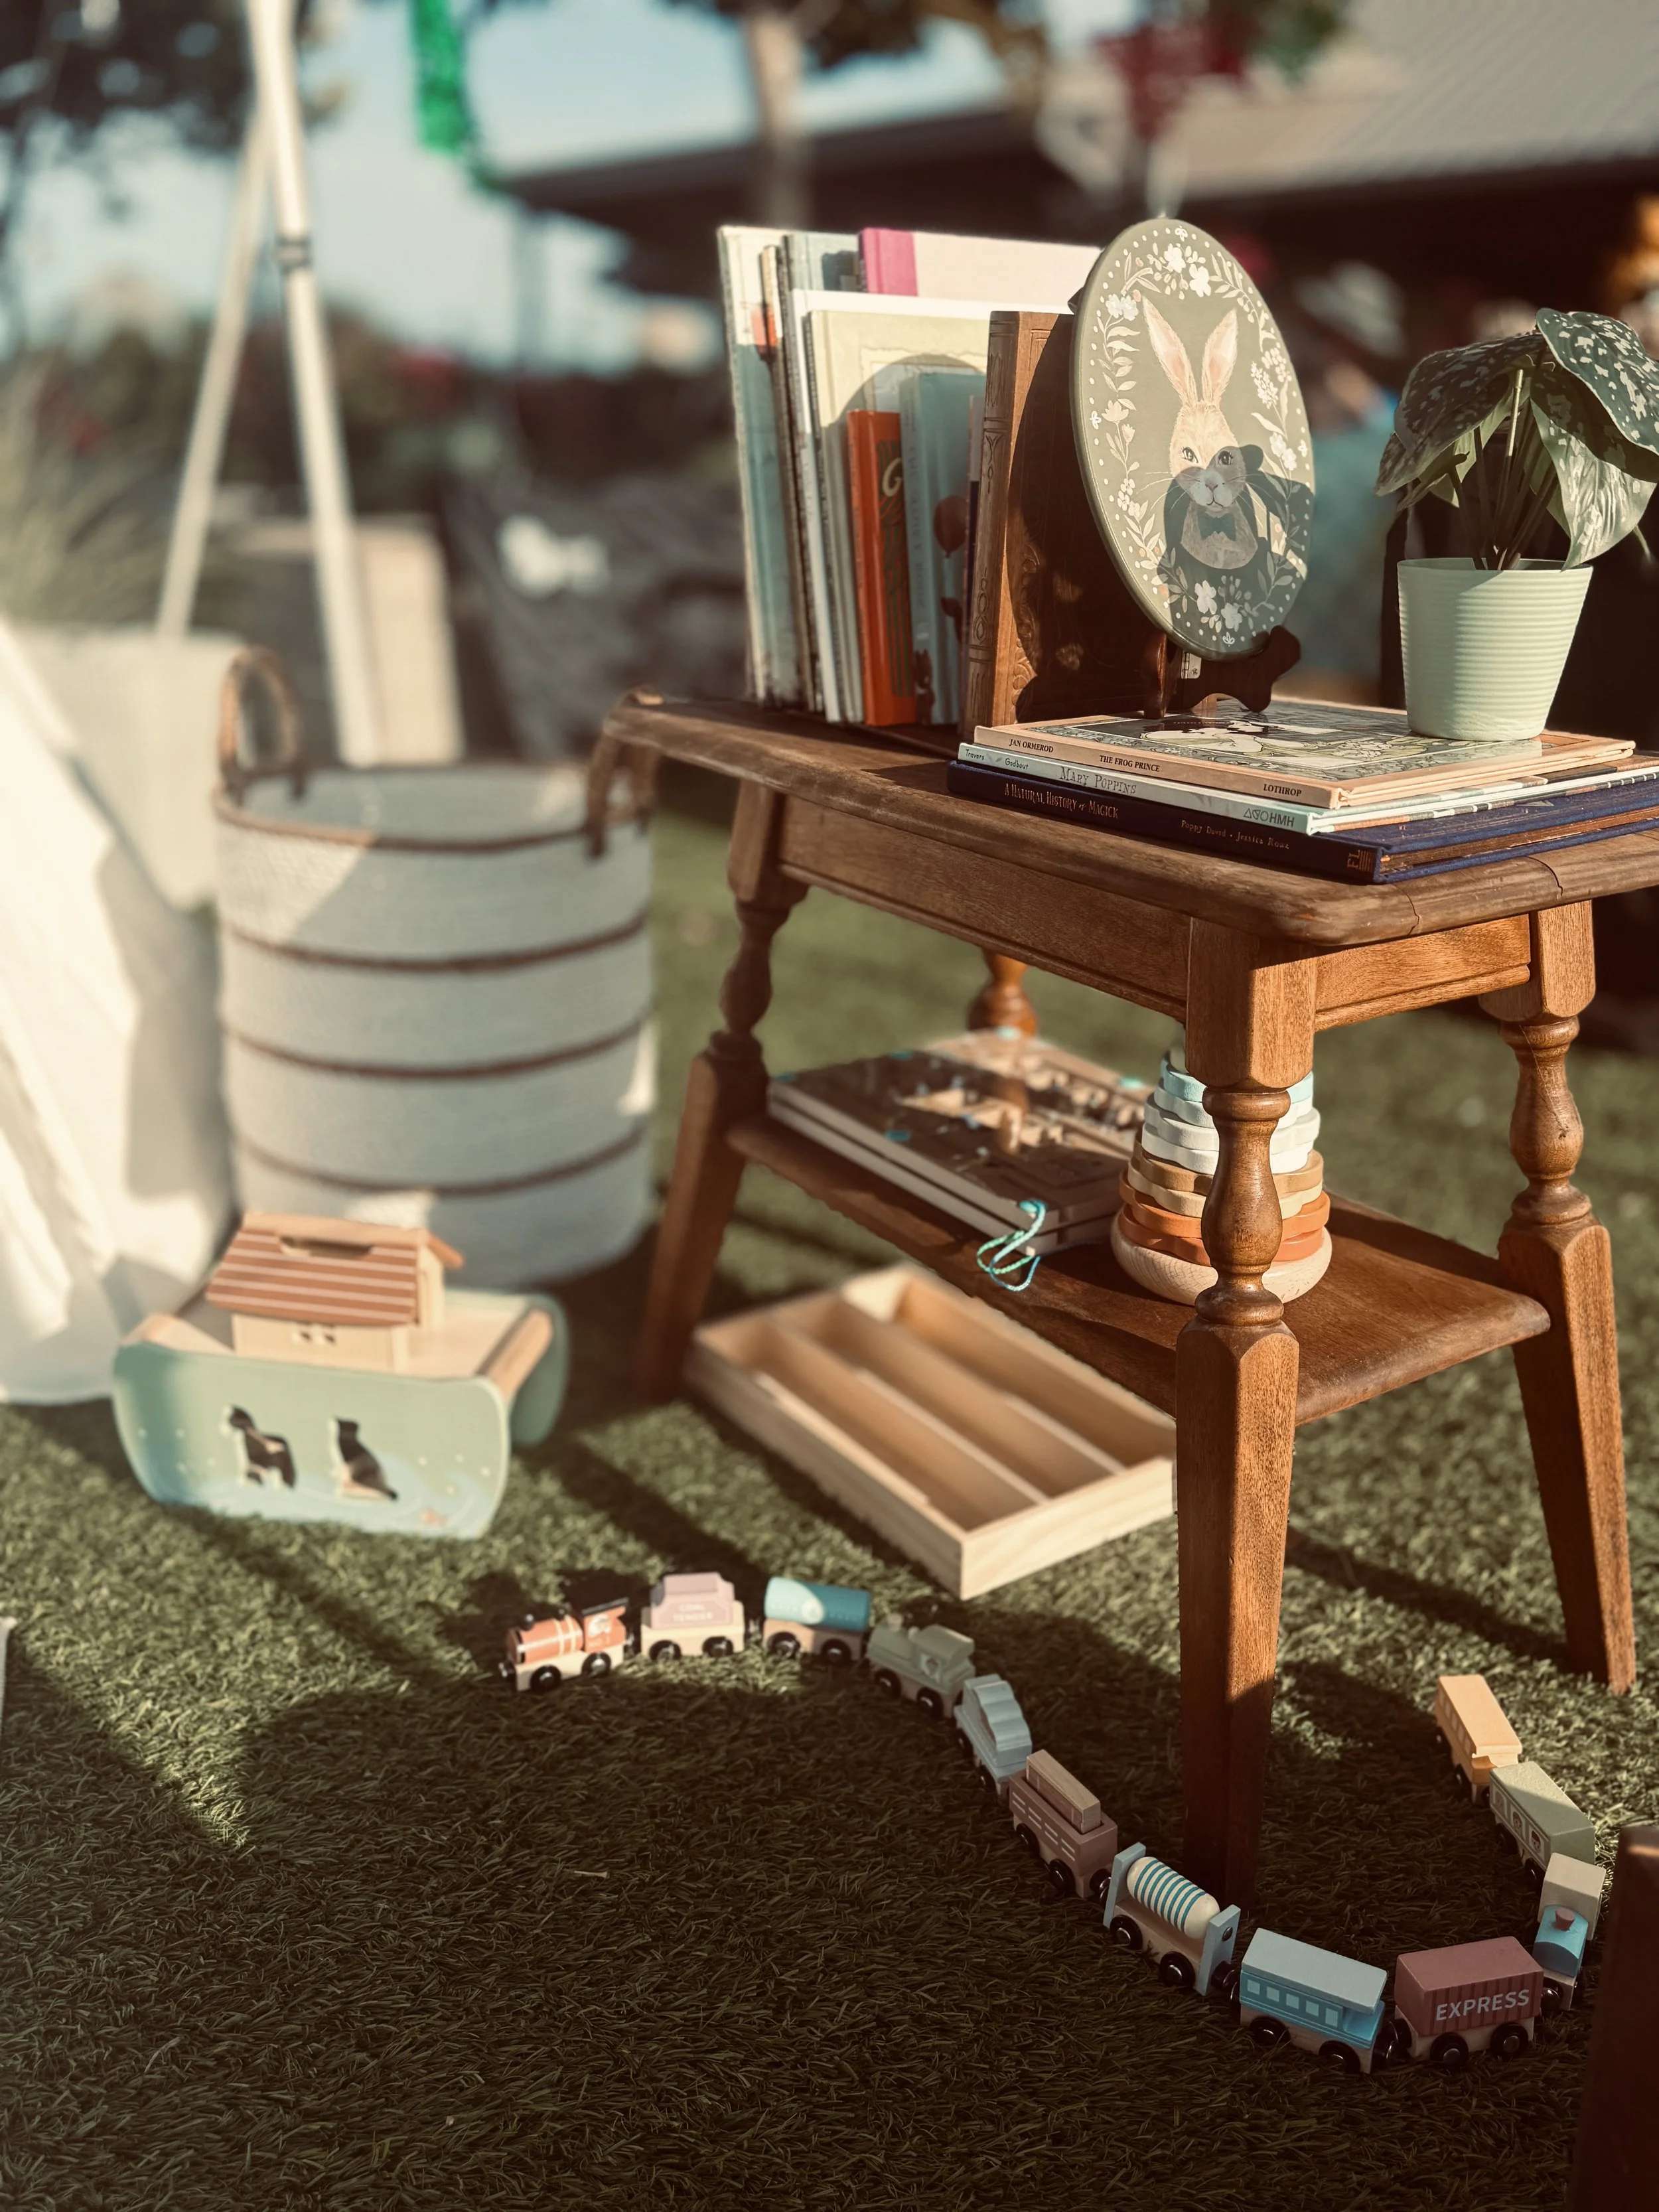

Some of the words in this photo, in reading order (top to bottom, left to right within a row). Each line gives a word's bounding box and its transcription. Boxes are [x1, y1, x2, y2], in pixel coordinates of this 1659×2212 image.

[1009, 739, 1021, 748] JAN
[1023, 741, 1054, 753] ORMEROD
[1005, 758, 1029, 770] Godbout
[1100, 755, 1113, 764] THE
[1114, 758, 1133, 767] FROG
[1134, 761, 1161, 773] PRINCE
[1263, 784, 1302, 796] LOTHROP
[1005, 783, 1010, 796] A
[1046, 791, 1078, 812] HISTORY
[1088, 800, 1119, 819] MAGICK
[1269, 812, 1295, 828] HMH
[1181, 820, 1202, 834] Poppy
[1206, 826, 1226, 838] David
[1236, 832, 1263, 845] Jessica
[1435, 1988, 1530, 2022] EXPRESS
